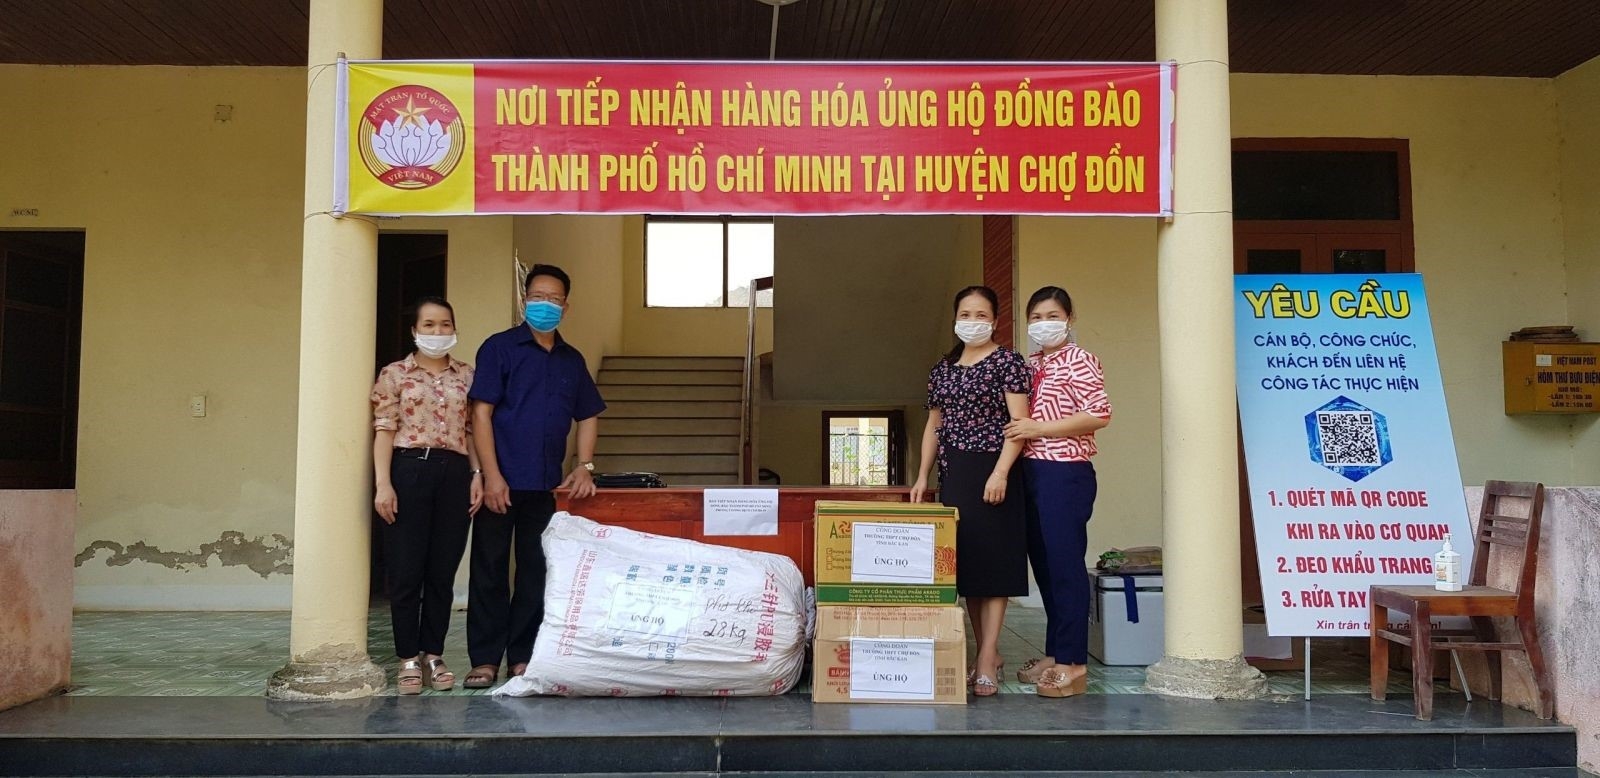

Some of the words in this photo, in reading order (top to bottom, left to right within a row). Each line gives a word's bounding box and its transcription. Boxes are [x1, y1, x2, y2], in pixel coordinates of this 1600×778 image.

[496, 84, 547, 126] NƠI
[556, 77, 619, 126] TIẾP
[630, 82, 712, 134] NHẬN
[722, 82, 800, 126] HÀNG
[811, 82, 868, 126] HÓA
[879, 78, 937, 127] ỦNG
[948, 82, 985, 135] HỘ
[994, 78, 1073, 127] ĐỒNG
[1084, 82, 1140, 127] BÀO
[412, 171, 434, 182] NAM
[492, 146, 589, 192] THÀNH
[600, 142, 658, 192] PHỐ
[668, 142, 706, 192] HỒ
[717, 147, 764, 192] CHÍ
[774, 155, 851, 192] MINH
[860, 156, 905, 200] TẠI
[915, 148, 1009, 200] HUYỆN
[1019, 151, 1076, 201] CHỢ
[1085, 143, 1144, 192] ĐỒN
[1242, 283, 1320, 319] YÊU
[1330, 279, 1411, 319] CẦU
[1254, 332, 1286, 347] CÁN
[1292, 333, 1316, 349] BỘ,
[1320, 333, 1366, 347] CÔNG
[1370, 332, 1416, 349] CHỨC,
[1267, 353, 1318, 368] KHÁCH
[1323, 352, 1351, 368] ĐẾN
[1356, 354, 1384, 368] LIÊN
[1389, 354, 1406, 370] HỆ
[1569, 357, 1581, 365] NAM
[1583, 357, 1596, 365] POST
[1261, 376, 1308, 390] CÔNG
[1312, 375, 1342, 390] TÁC
[1344, 377, 1382, 392] THỰC
[1387, 376, 1419, 392] HIỆN
[1268, 490, 1283, 506] 1.
[1287, 488, 1325, 508] QUÉT
[1331, 488, 1357, 507] MÃ
[1361, 491, 1382, 509] QR
[1386, 491, 1428, 508] CODE
[1287, 523, 1313, 539] KHI
[1318, 523, 1340, 540] RA
[1344, 520, 1375, 540] VÀO
[1380, 522, 1402, 540] CƠ
[1406, 524, 1449, 542] QUAN
[874, 555, 893, 566] ỦNG
[895, 558, 909, 568] HỘ
[1277, 557, 1292, 573] 2.
[1296, 557, 1327, 574] ĐEO
[1333, 550, 1375, 574] KHẨU
[1379, 557, 1433, 574] TRANG
[1282, 591, 1297, 607] 3.
[1301, 584, 1334, 608] RỬA
[1338, 591, 1367, 608] TAY
[1316, 620, 1335, 630] Xin
[873, 672, 892, 681] ỦNG
[894, 673, 908, 683] HỘ
